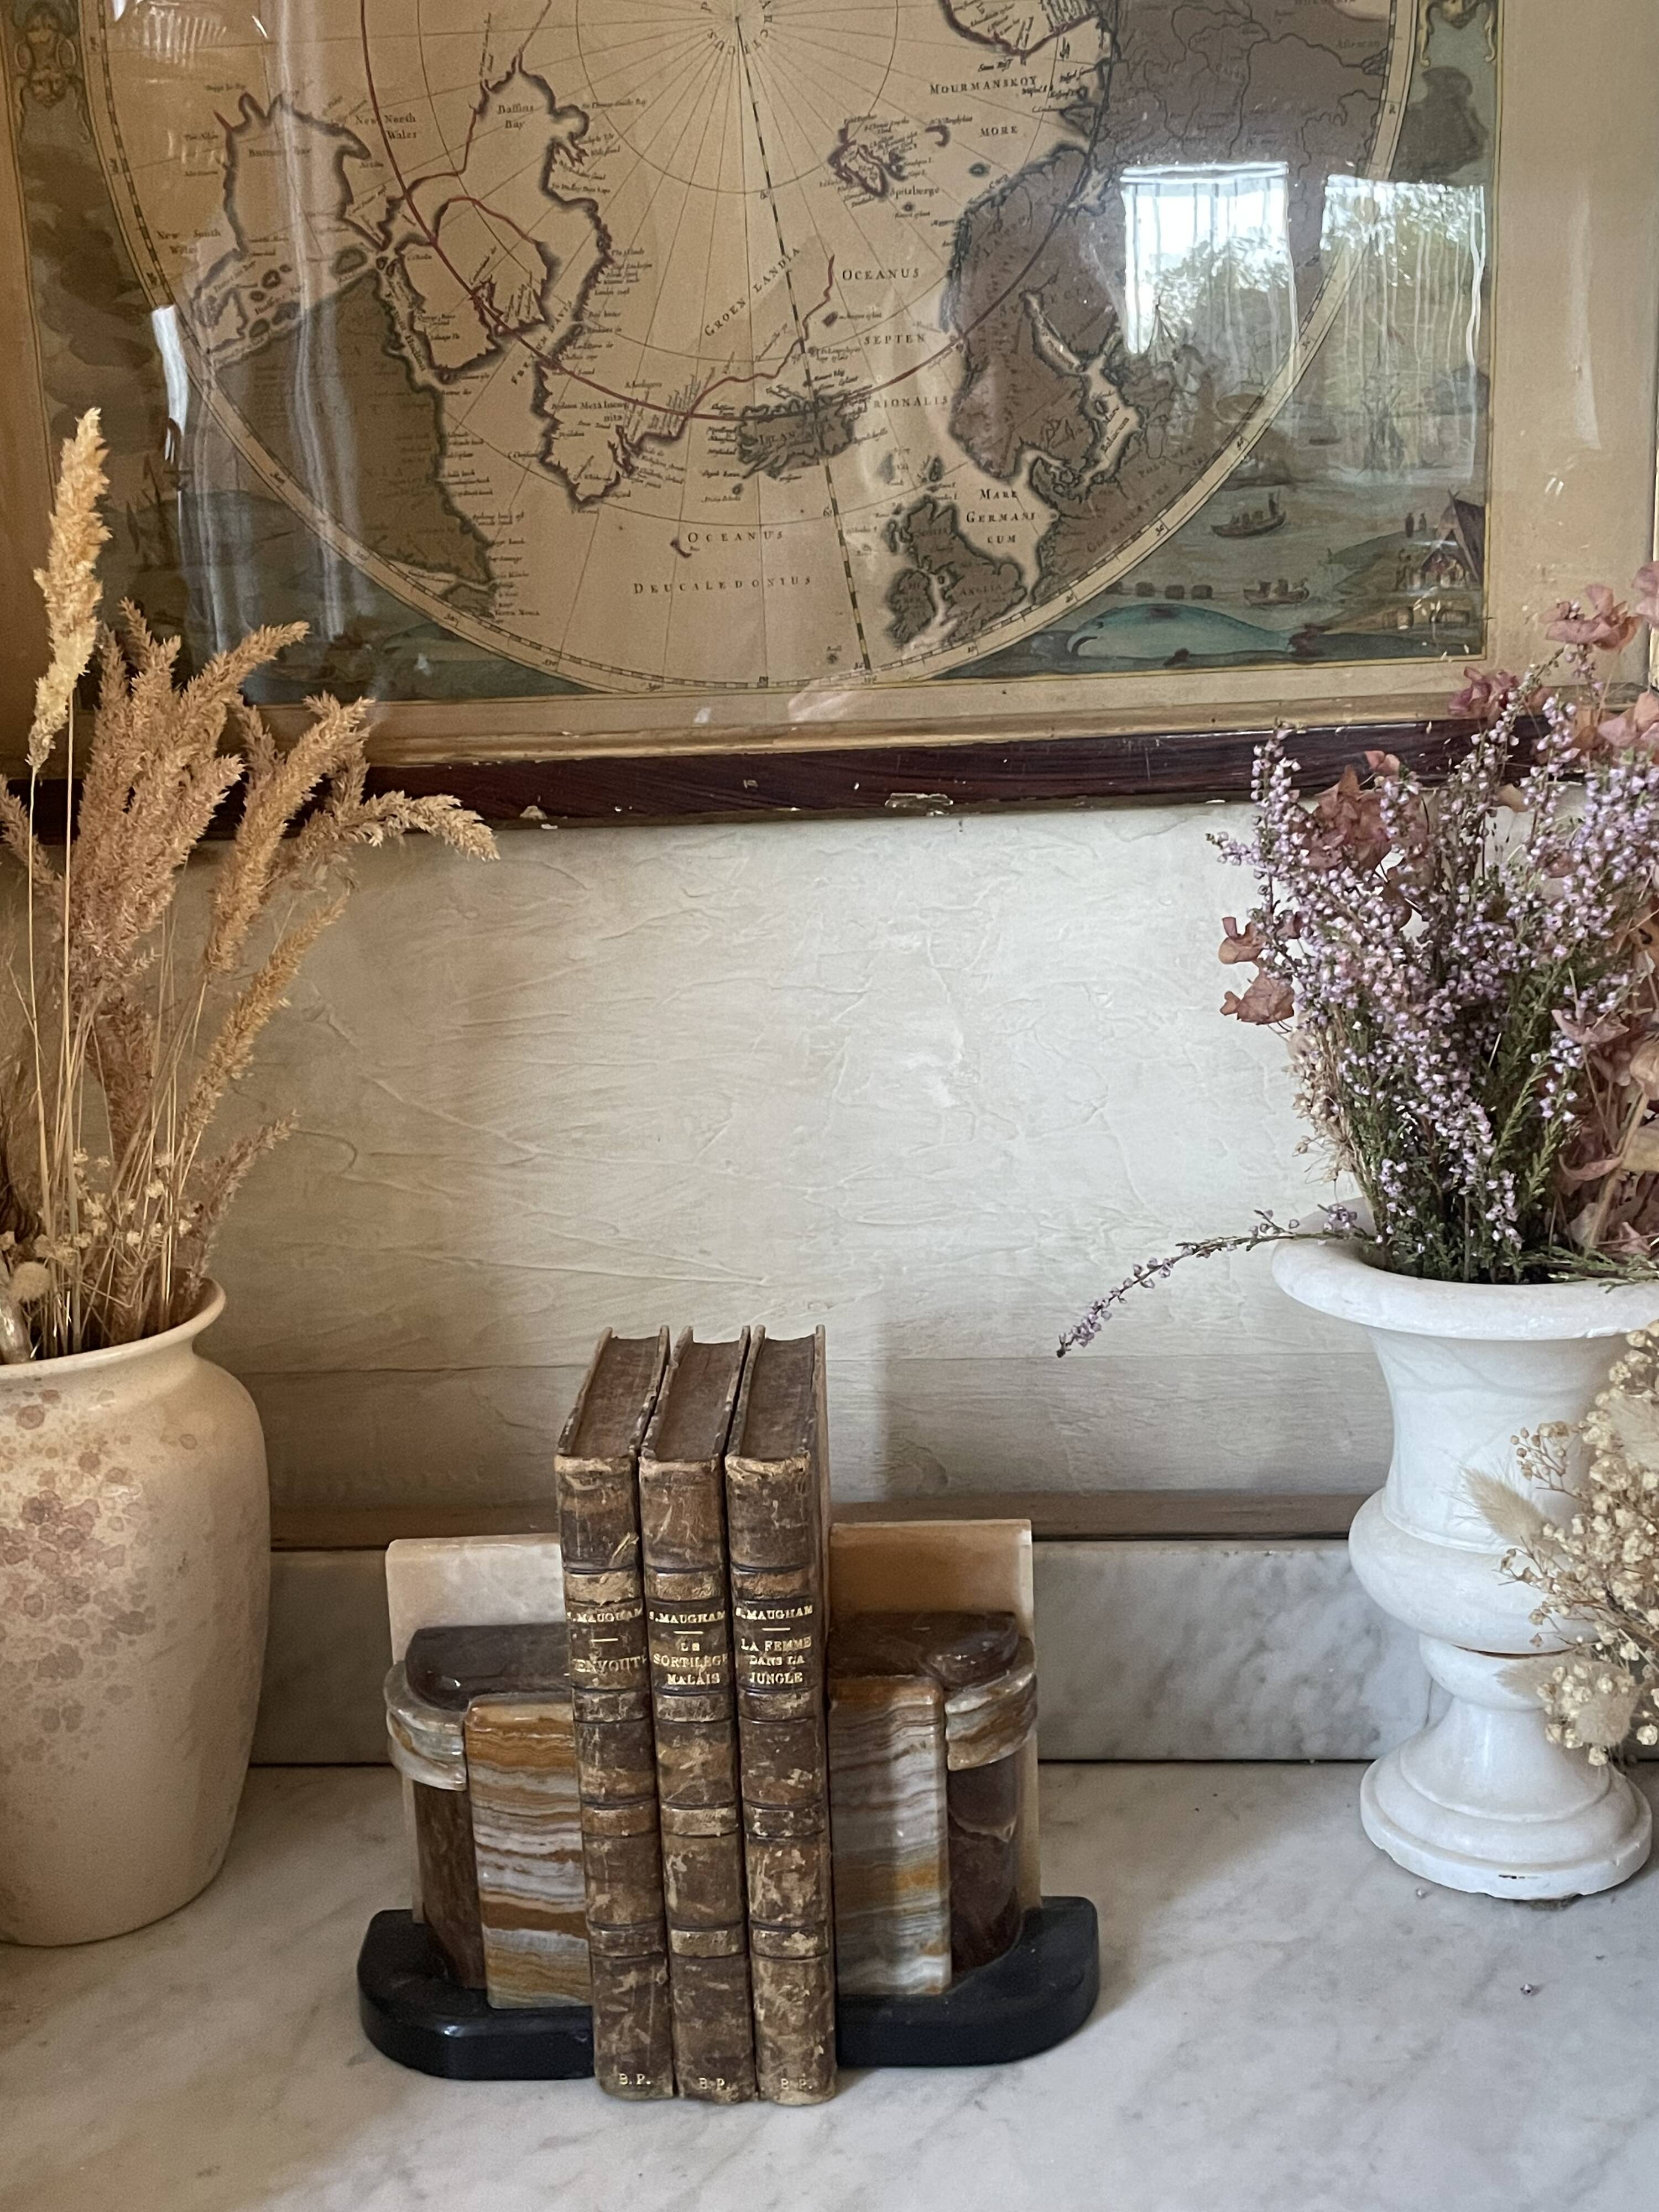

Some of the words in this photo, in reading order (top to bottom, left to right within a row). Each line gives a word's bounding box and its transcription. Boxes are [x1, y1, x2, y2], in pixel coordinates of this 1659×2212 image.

[930, 75, 1038, 95] MOURMANSKOY
[384, 112, 416, 124] North
[979, 126, 1019, 138] MORE
[194, 227, 221, 238] South
[842, 268, 920, 281] OCEANUS
[704, 297, 747, 336] GROEN
[864, 333, 926, 345] SEPTEN
[687, 530, 784, 544] OCEANUS
[987, 534, 1017, 544] CUM
[633, 576, 811, 594] DEUCALEDONIUS
[649, 1610, 726, 1624] S.MAUGHAM
[735, 1604, 813, 1620] S.MAUGHAM
[740, 1637, 759, 1652] LA
[764, 1635, 812, 1652] FEMME
[749, 1655, 782, 1666] DANS
[787, 1655, 805, 1665] LA
[667, 1673, 721, 1686] MALAIS
[749, 1672, 804, 1685] JUNGLE
